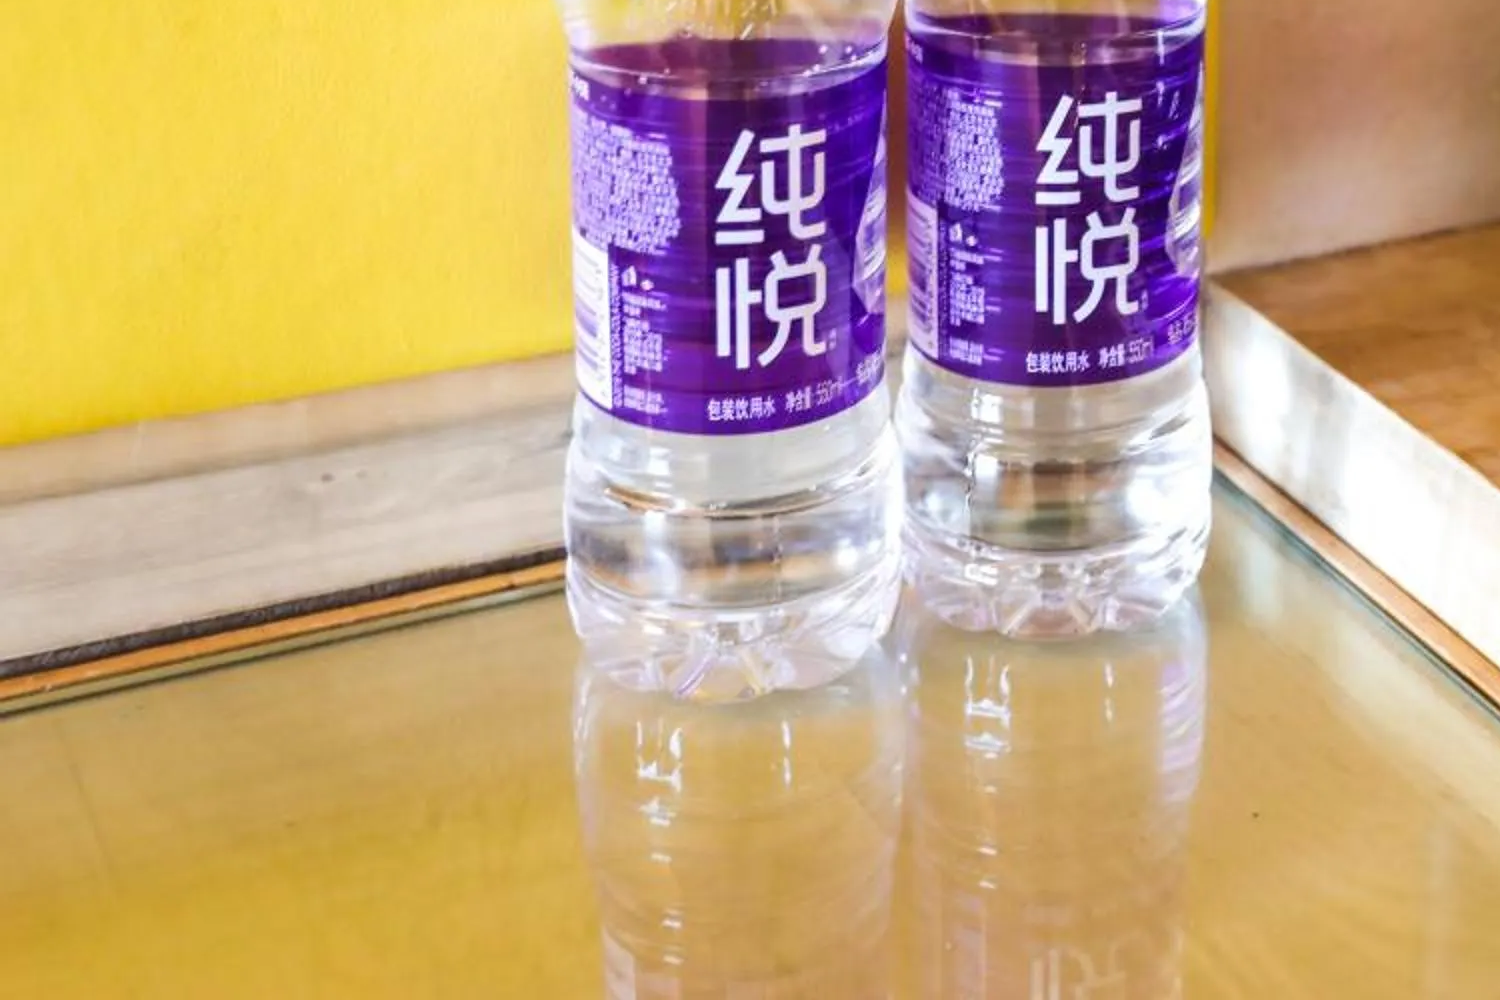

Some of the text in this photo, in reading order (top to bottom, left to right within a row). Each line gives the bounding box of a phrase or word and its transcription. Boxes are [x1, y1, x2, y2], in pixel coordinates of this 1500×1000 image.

[714, 123, 827, 370] 纯悦
[1035, 91, 1143, 325] 纯悦
[706, 394, 777, 421] 包装饮用水
[1025, 350, 1091, 374] 包装饮用水
